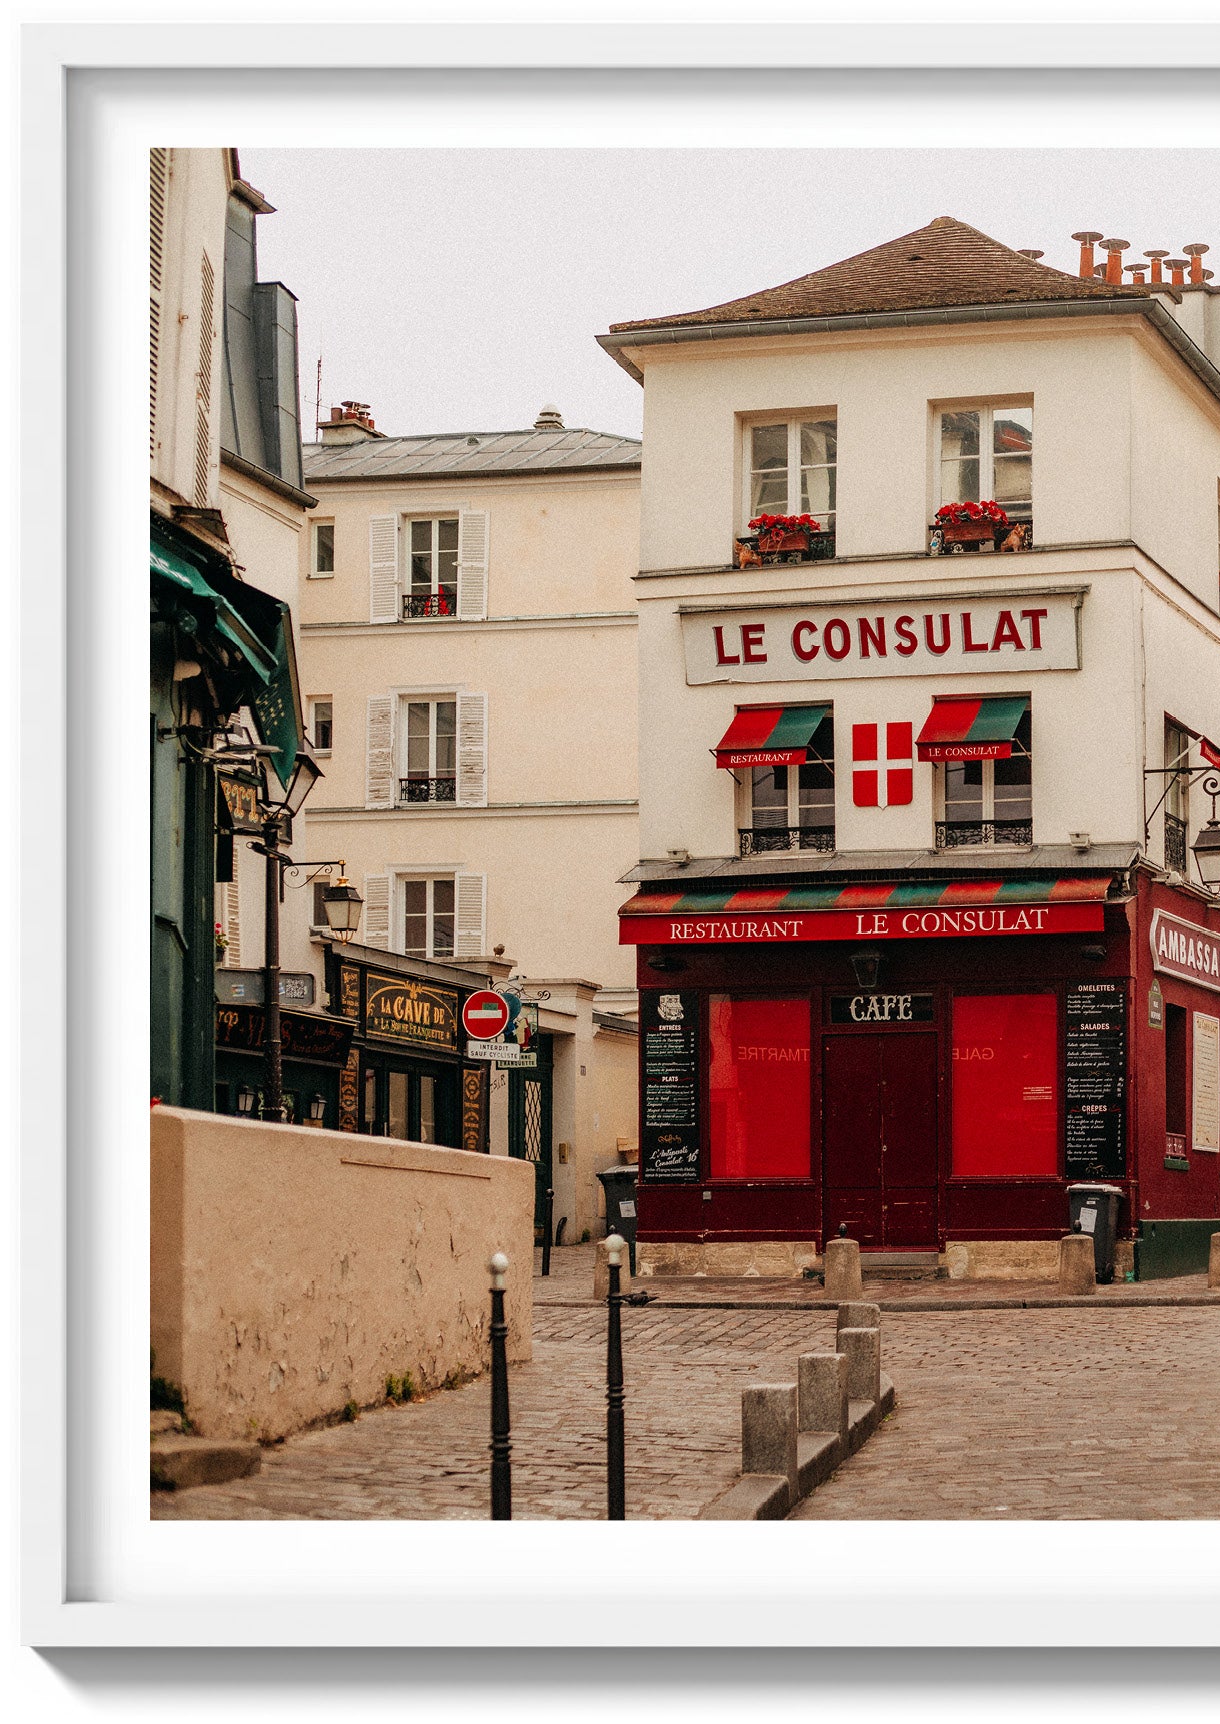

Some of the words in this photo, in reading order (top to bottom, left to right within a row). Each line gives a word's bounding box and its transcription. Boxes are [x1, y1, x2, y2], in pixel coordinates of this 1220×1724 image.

[712, 623, 768, 667] LE
[791, 609, 1048, 664] CONSULAT
[928, 747, 941, 757] LE
[945, 745, 1000, 756] CONSULAT
[730, 753, 793, 764] RESTAURANT
[670, 920, 803, 940] RESTAURANT
[855, 914, 889, 935] LE
[902, 908, 1049, 933] CONSULAT
[1078, 984, 1115, 992] OMELETTES
[381, 996, 391, 1014] LA
[393, 996, 430, 1025] CAVE
[433, 1007, 445, 1025] DE
[849, 995, 913, 1021] CAFE
[489, 1051, 518, 1059] CYCLISTE
[1081, 1104, 1108, 1112] CRÊPES
